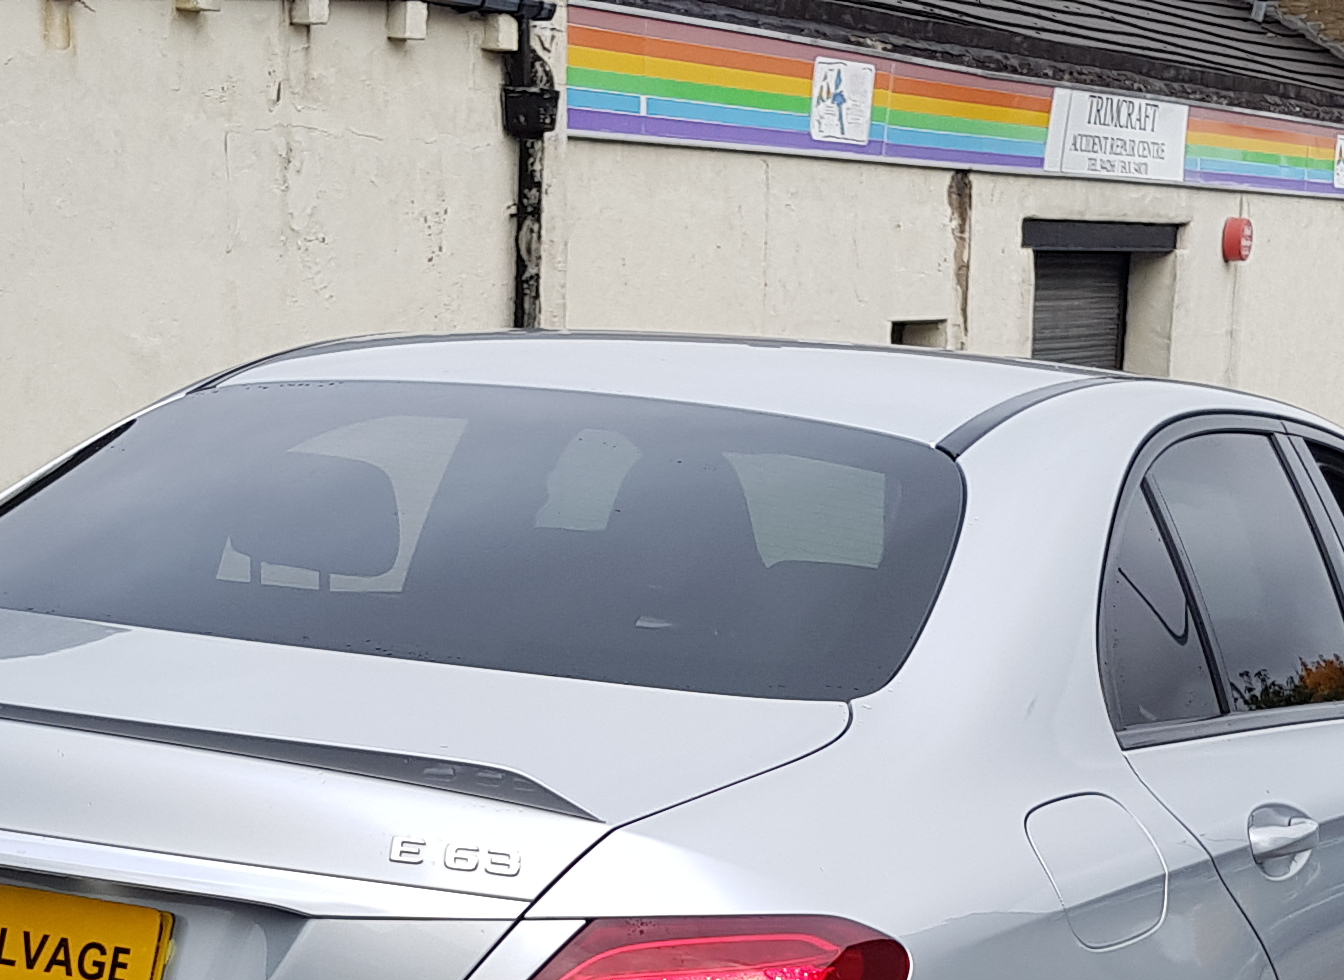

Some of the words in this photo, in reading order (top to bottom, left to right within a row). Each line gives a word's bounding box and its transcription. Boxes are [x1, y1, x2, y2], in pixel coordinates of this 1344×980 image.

[1087, 94, 1159, 132] TRIMCRAFT
[389, 835, 426, 865] E
[443, 842, 522, 877] 63
